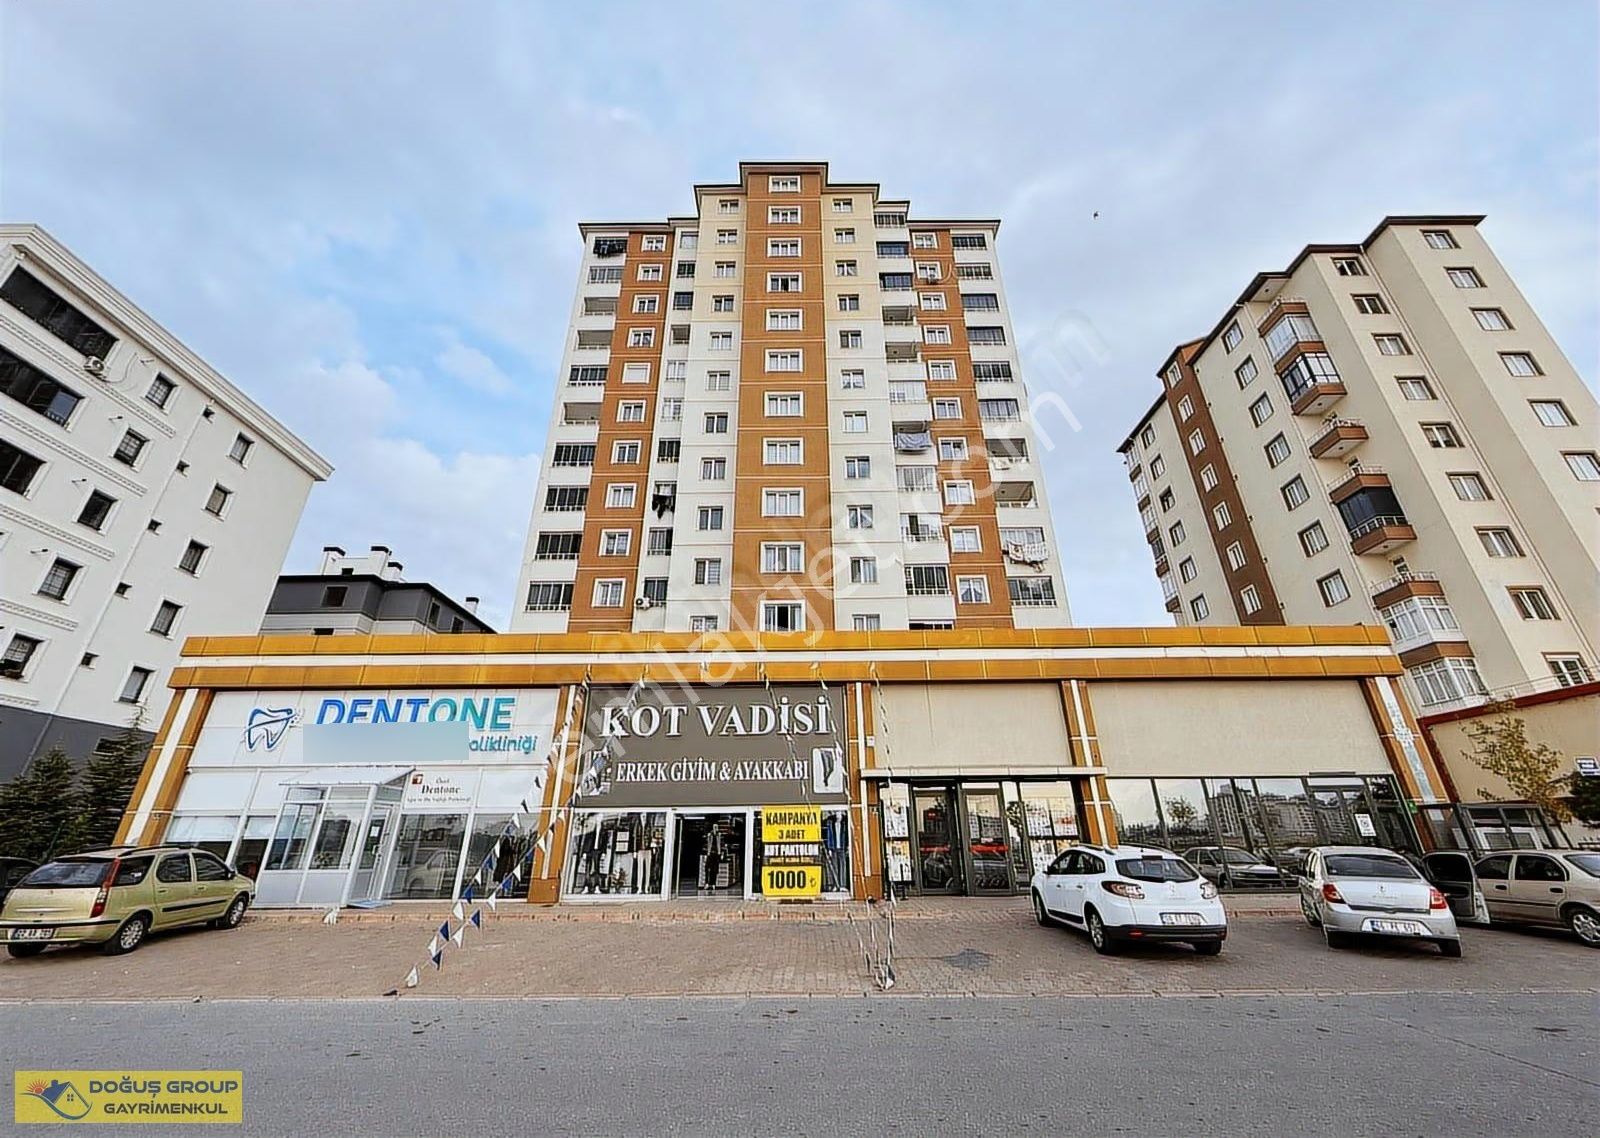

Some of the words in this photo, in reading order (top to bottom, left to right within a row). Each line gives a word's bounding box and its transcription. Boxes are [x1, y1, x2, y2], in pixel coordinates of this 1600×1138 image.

[315, 697, 516, 730] DENTONE
[600, 705, 688, 737] KOT
[697, 696, 833, 737] VADİSİ
[469, 734, 538, 755] olikliniği
[616, 761, 670, 782] ERKEK
[671, 757, 716, 782] GİYİM
[719, 761, 732, 781] &
[733, 760, 809, 781] AYAKKABI
[421, 784, 461, 795] Dentone
[766, 812, 818, 826] KAMPANYA
[778, 830, 785, 839] 3
[786, 830, 806, 839] ADET
[768, 869, 807, 889] 1000
